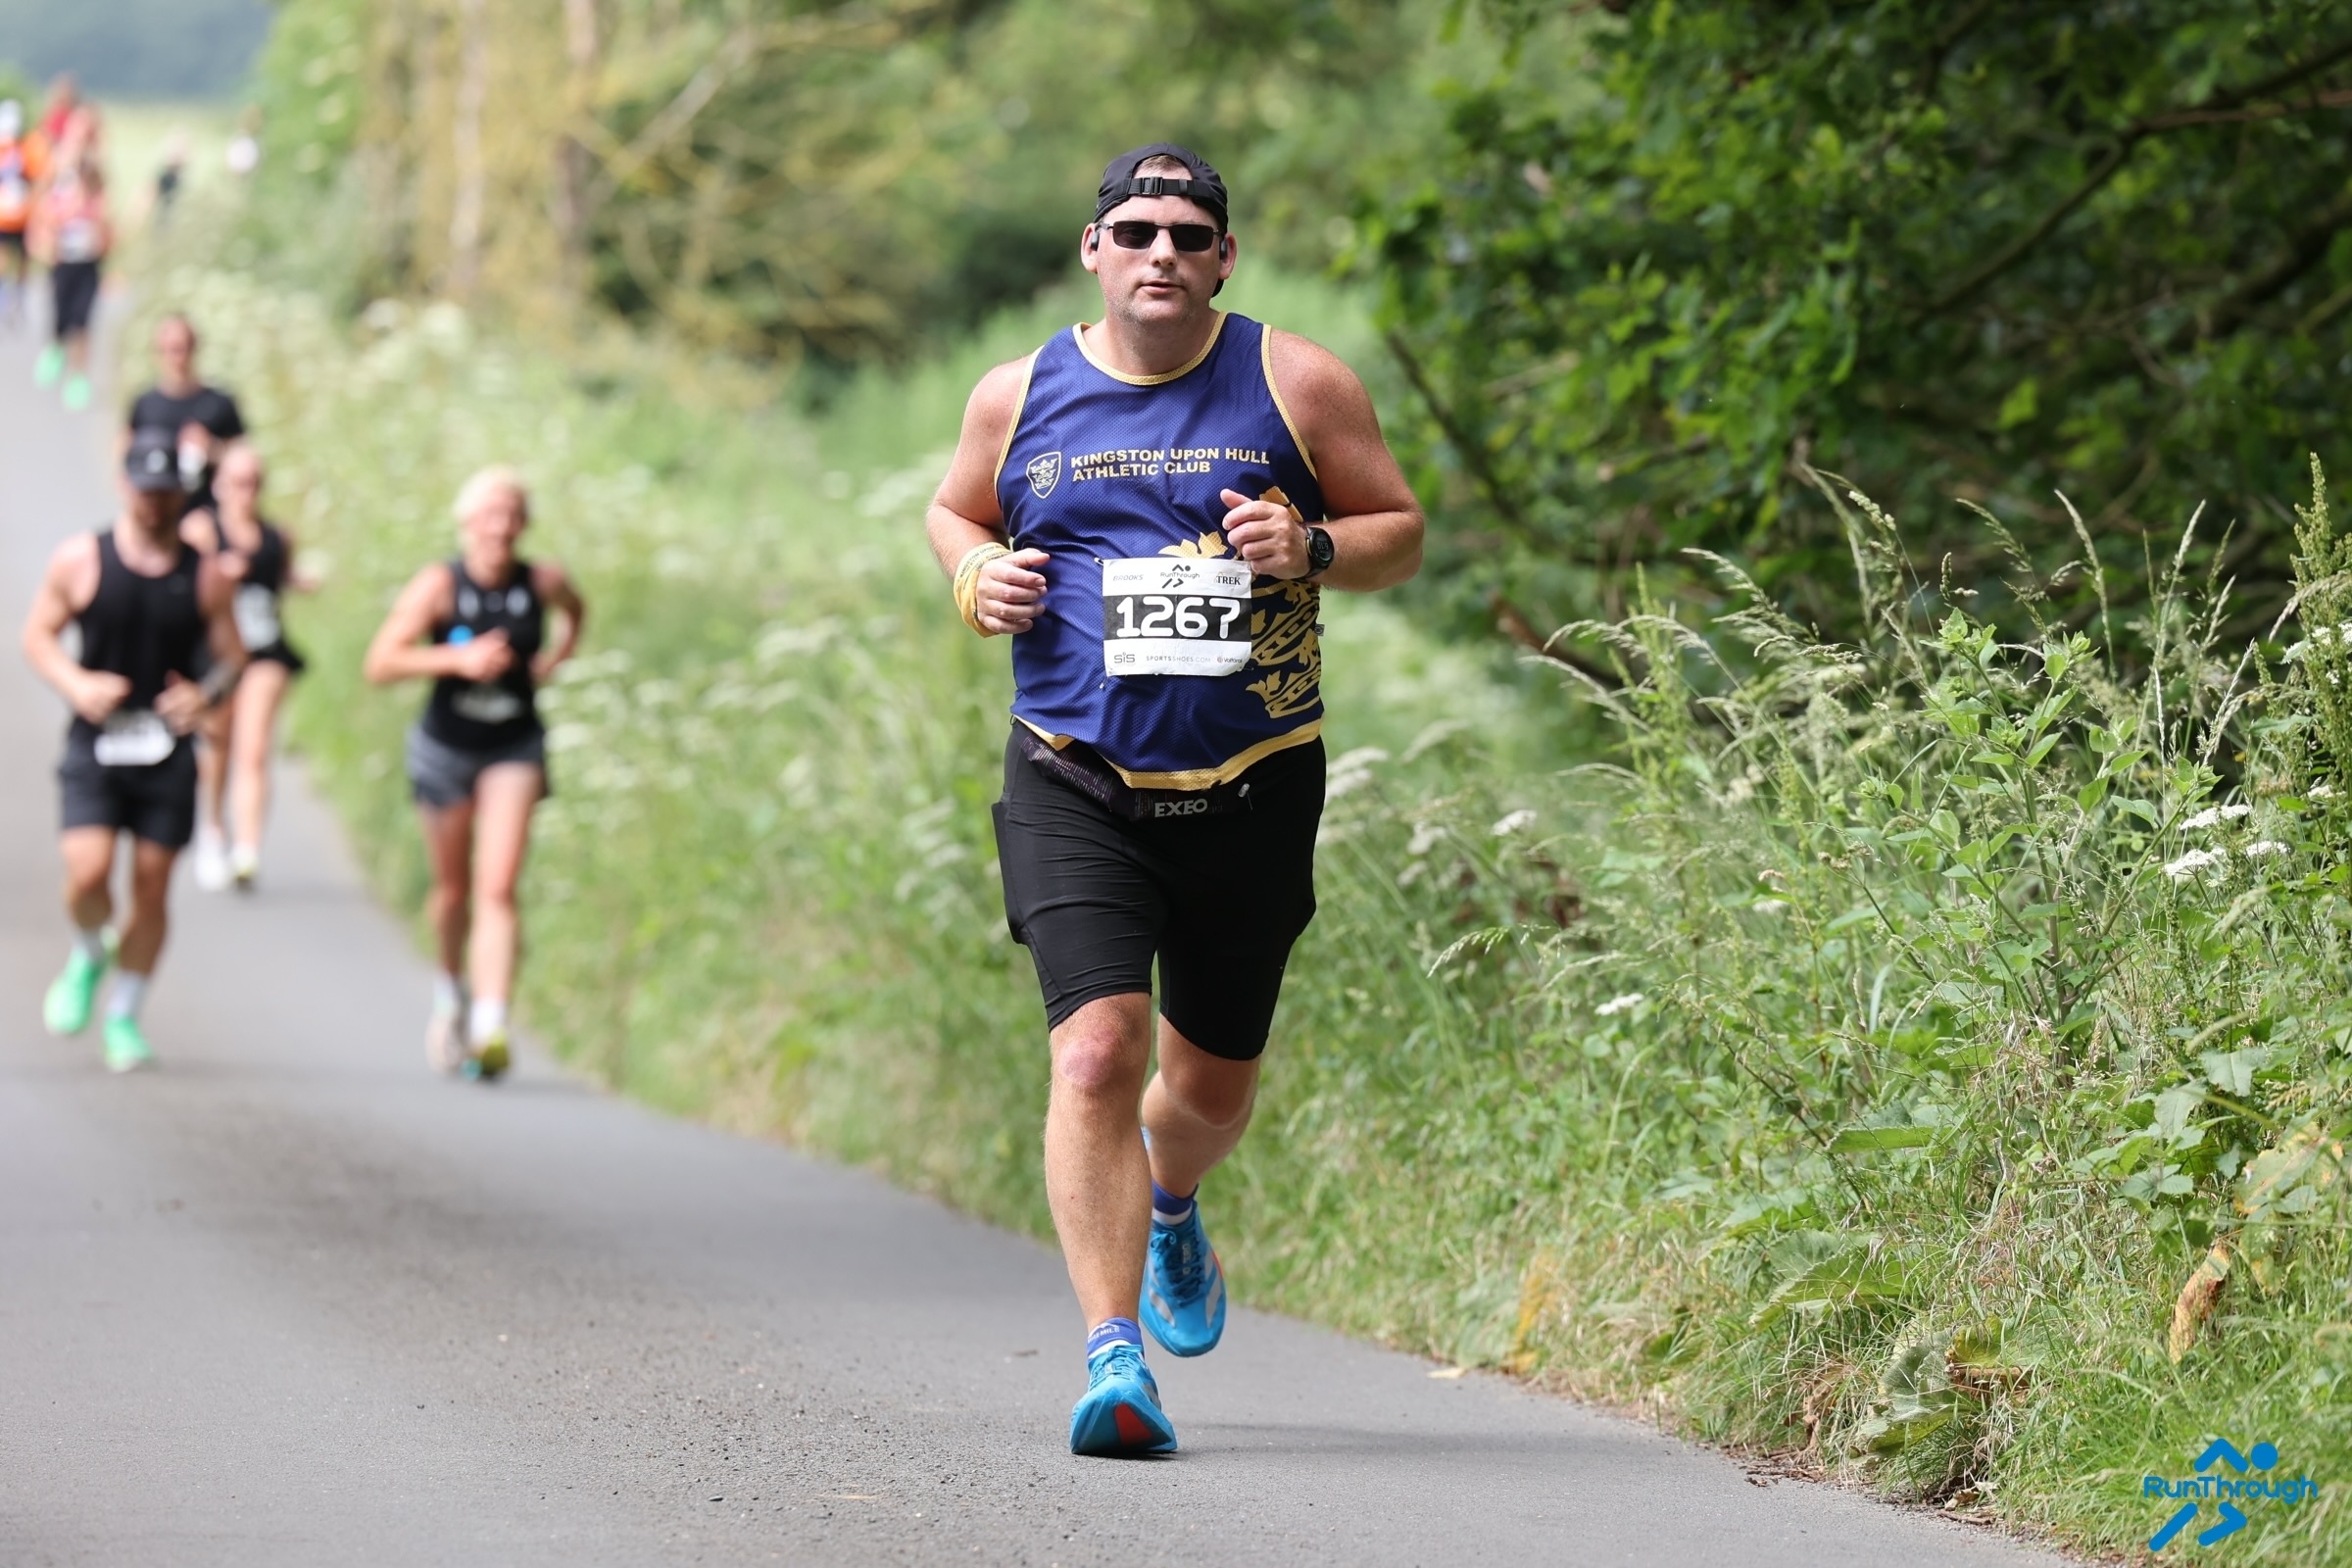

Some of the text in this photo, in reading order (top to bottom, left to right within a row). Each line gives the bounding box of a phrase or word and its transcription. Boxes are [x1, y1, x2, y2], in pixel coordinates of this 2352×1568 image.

[1070, 448, 1270, 467] KINGSTON UPON HULL
[1072, 461, 1211, 482] ATHLETIC CLUB
[1215, 575, 1241, 585] TREK
[1116, 596, 1241, 639] 1267
[1154, 798, 1208, 817] EXEO
